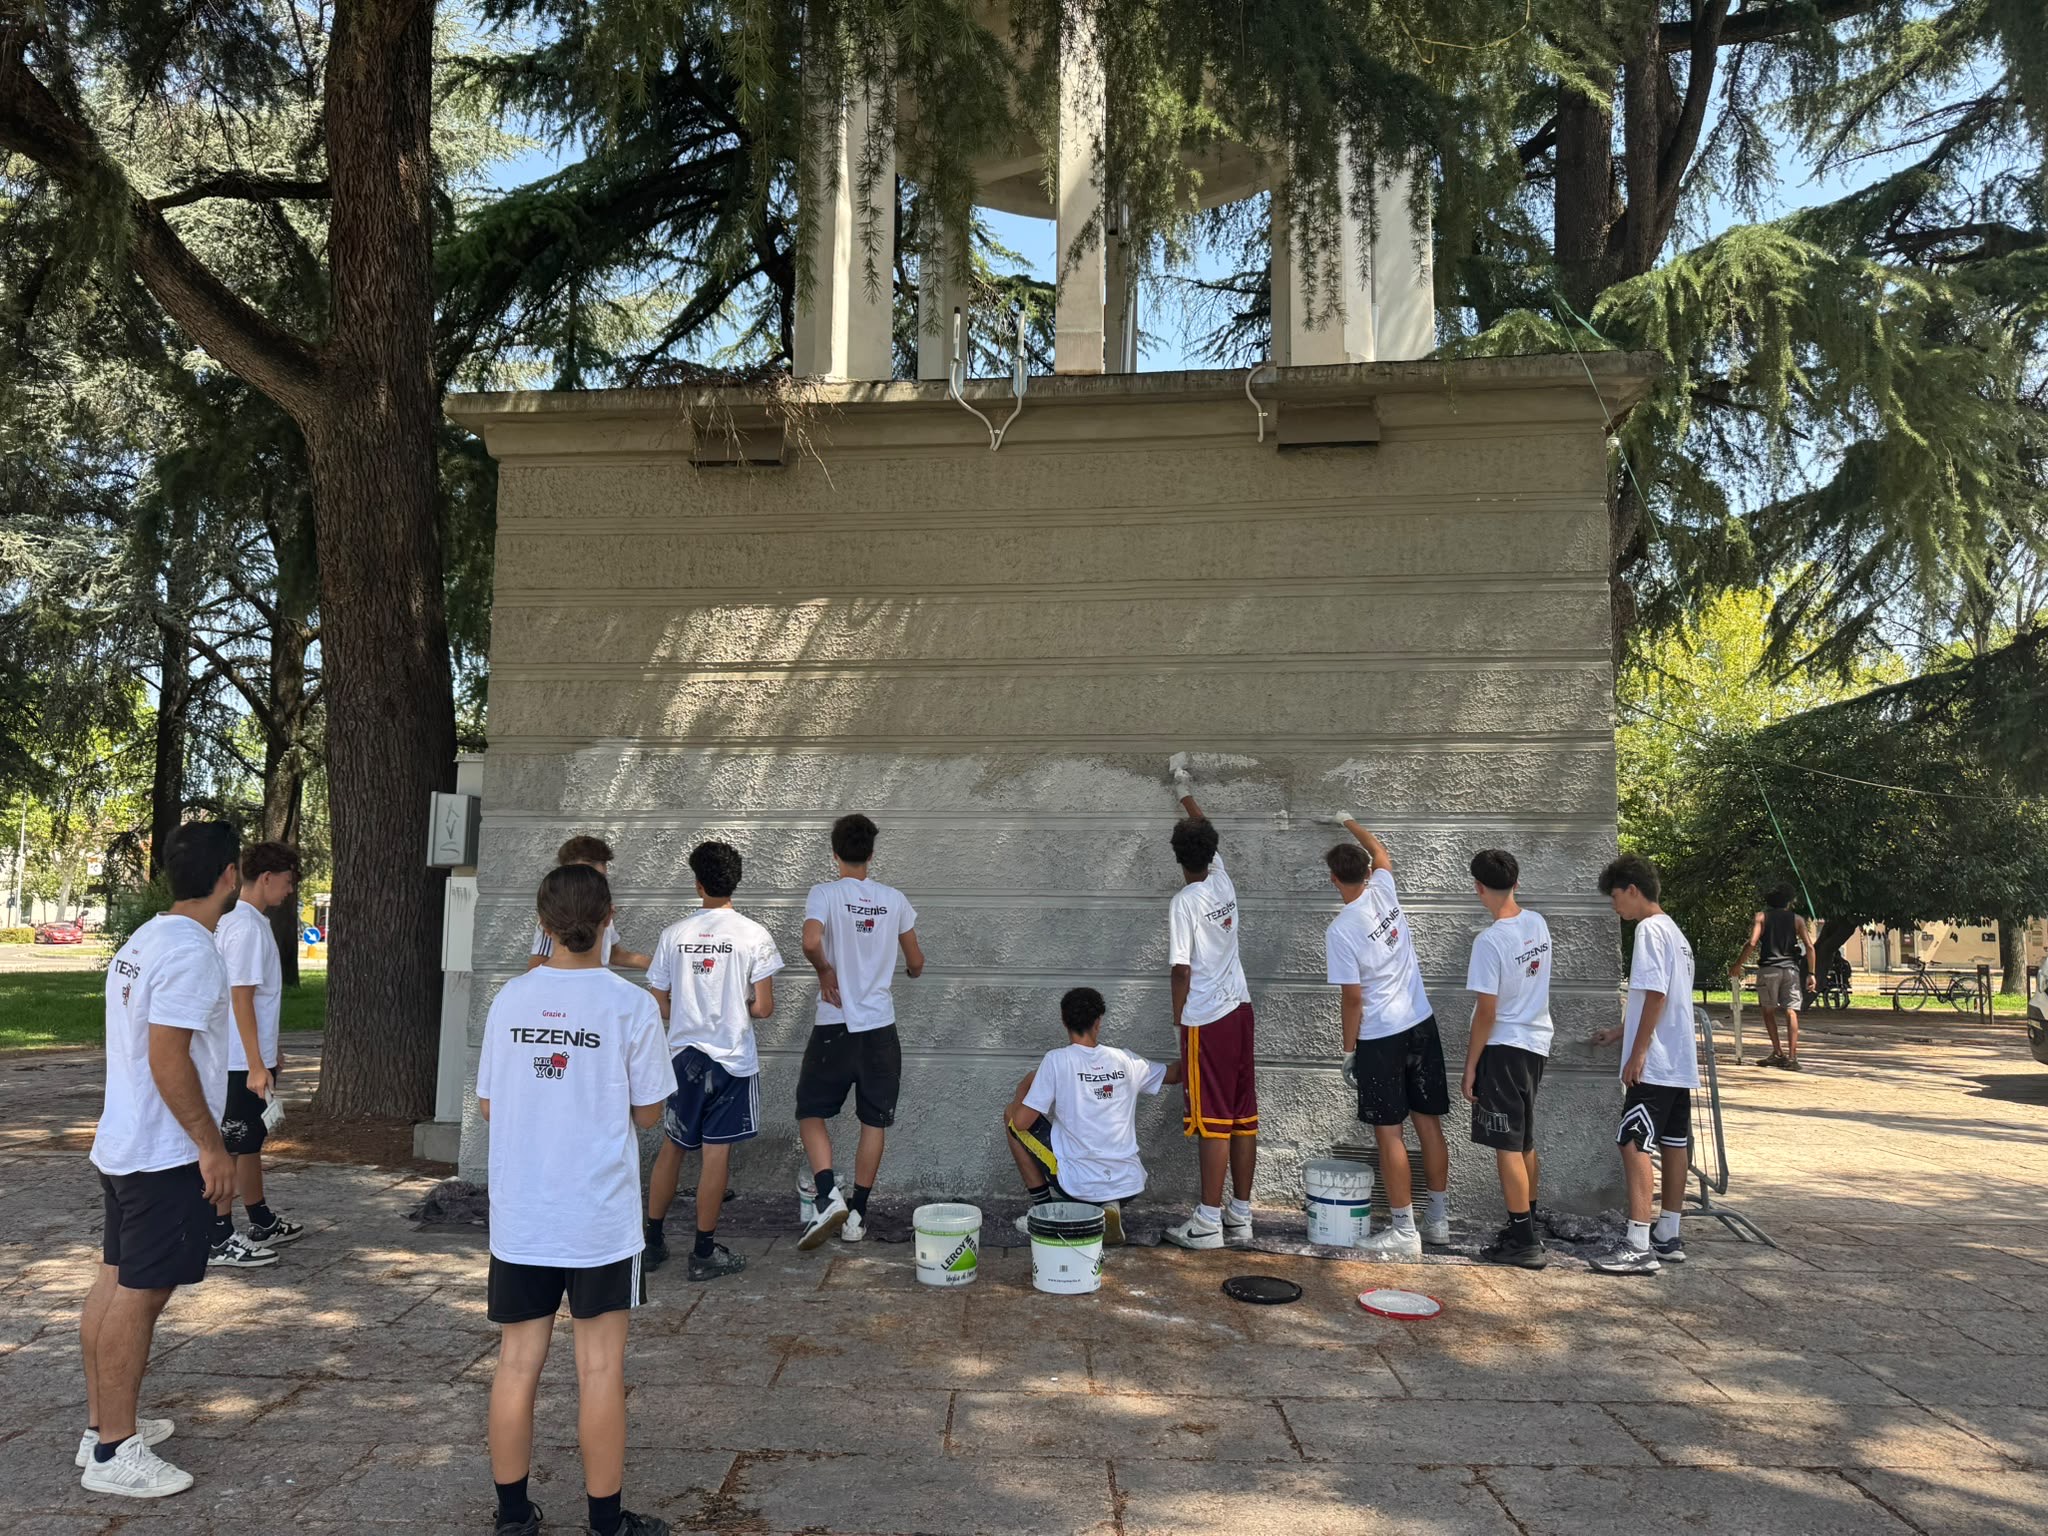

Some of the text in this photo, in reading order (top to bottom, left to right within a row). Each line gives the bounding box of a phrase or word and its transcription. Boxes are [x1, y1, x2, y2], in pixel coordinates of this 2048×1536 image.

[844, 903, 888, 916] TEZENIS
[1367, 906, 1400, 942] TEZENIS
[677, 942, 733, 954] TEZENIS
[542, 1010, 561, 1018] Grazie
[510, 1028, 601, 1049] TEZENIS
[535, 1065, 566, 1080] YOU
[1077, 1069, 1125, 1083] TEZENIS
[940, 1240, 967, 1271] LEROY
